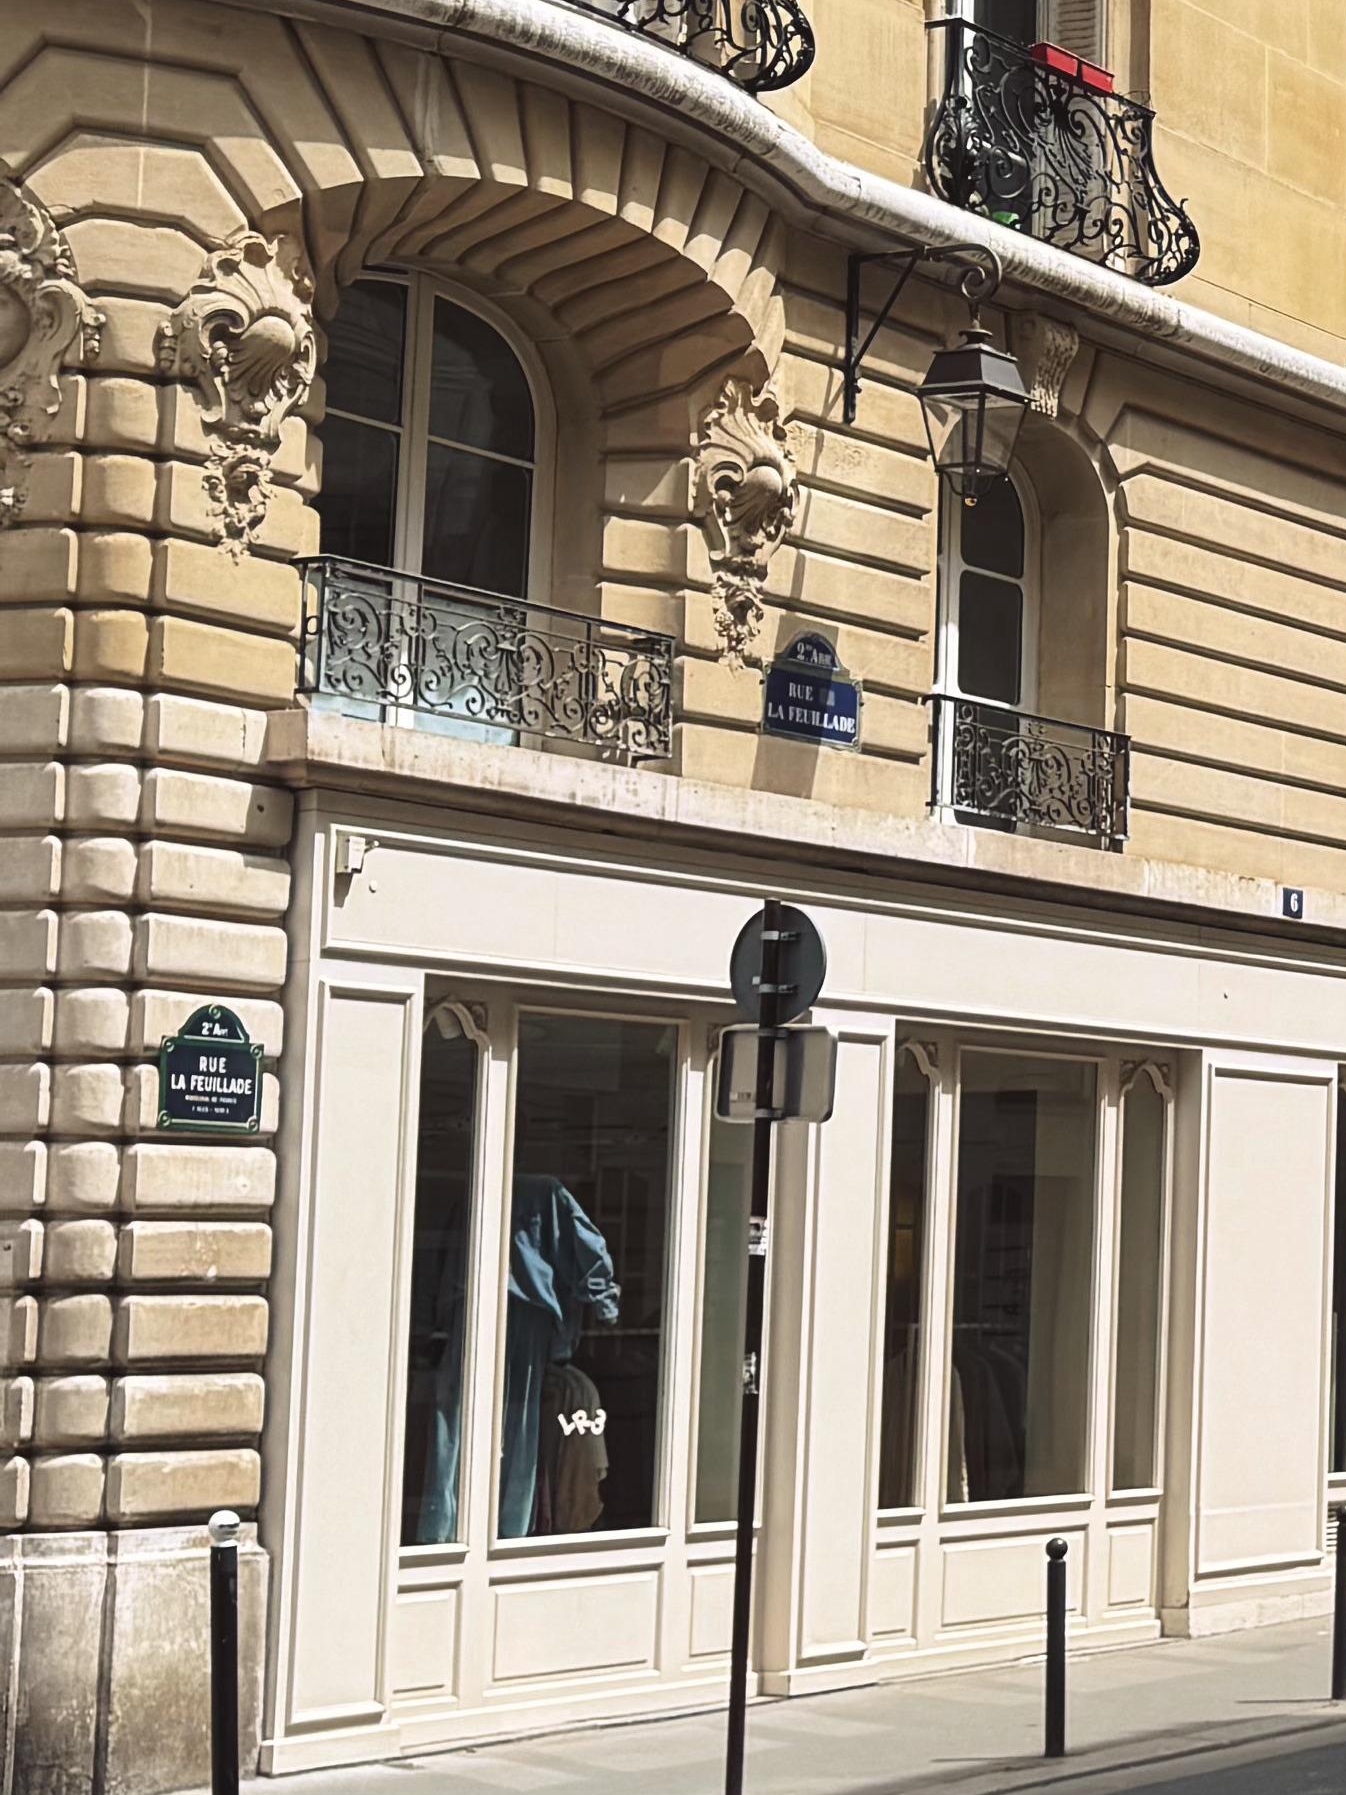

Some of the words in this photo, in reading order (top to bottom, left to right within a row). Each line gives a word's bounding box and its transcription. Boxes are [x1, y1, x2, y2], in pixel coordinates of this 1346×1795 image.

[789, 682, 813, 701] RUE
[768, 702, 784, 721] LA
[789, 706, 856, 734] FEUILLADE
[1290, 893, 1299, 912] 6
[199, 1056, 227, 1073] RUE
[171, 1074, 186, 1090] LA
[190, 1075, 252, 1094] FEUILLADE
